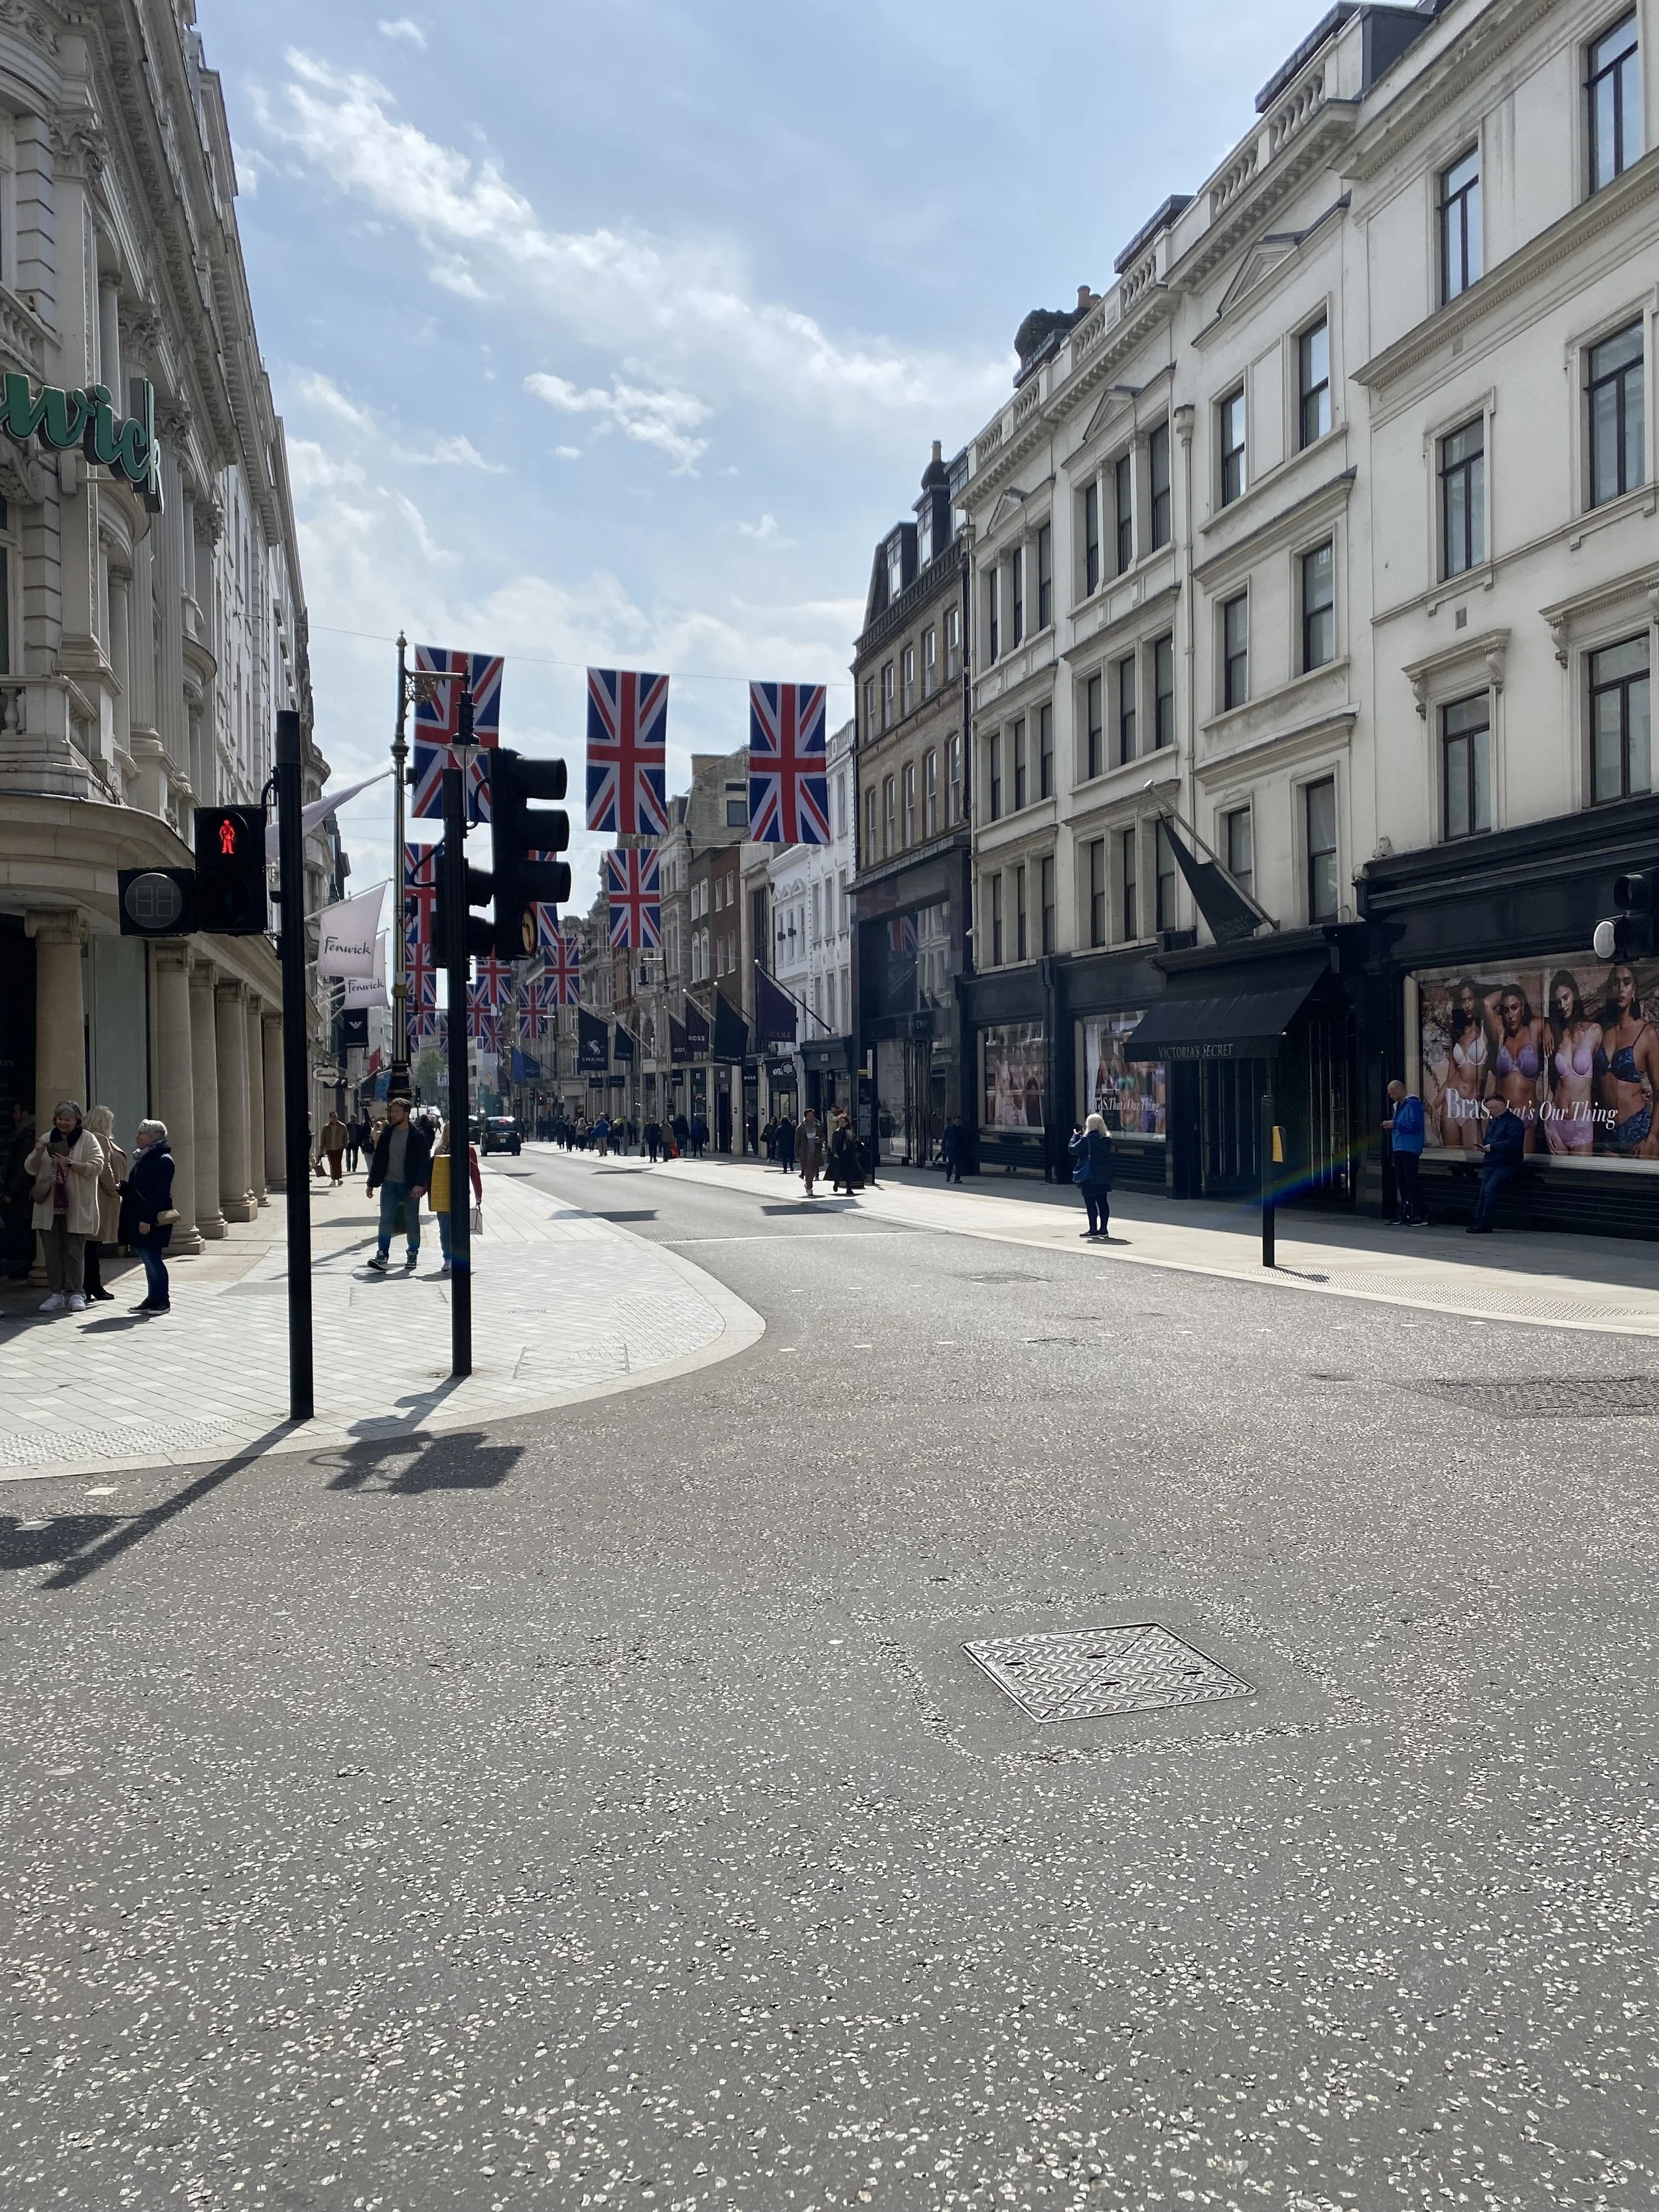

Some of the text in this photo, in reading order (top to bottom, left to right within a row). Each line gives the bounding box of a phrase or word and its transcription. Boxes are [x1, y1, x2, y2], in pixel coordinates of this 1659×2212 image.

[324, 936, 372, 955] Fenwick
[347, 978, 385, 994] Fenwick
[1157, 1043, 1234, 1060] VICTORIA'S SECRET
[1539, 1100, 1569, 1122] Our
[1571, 1100, 1619, 1131] Thing
